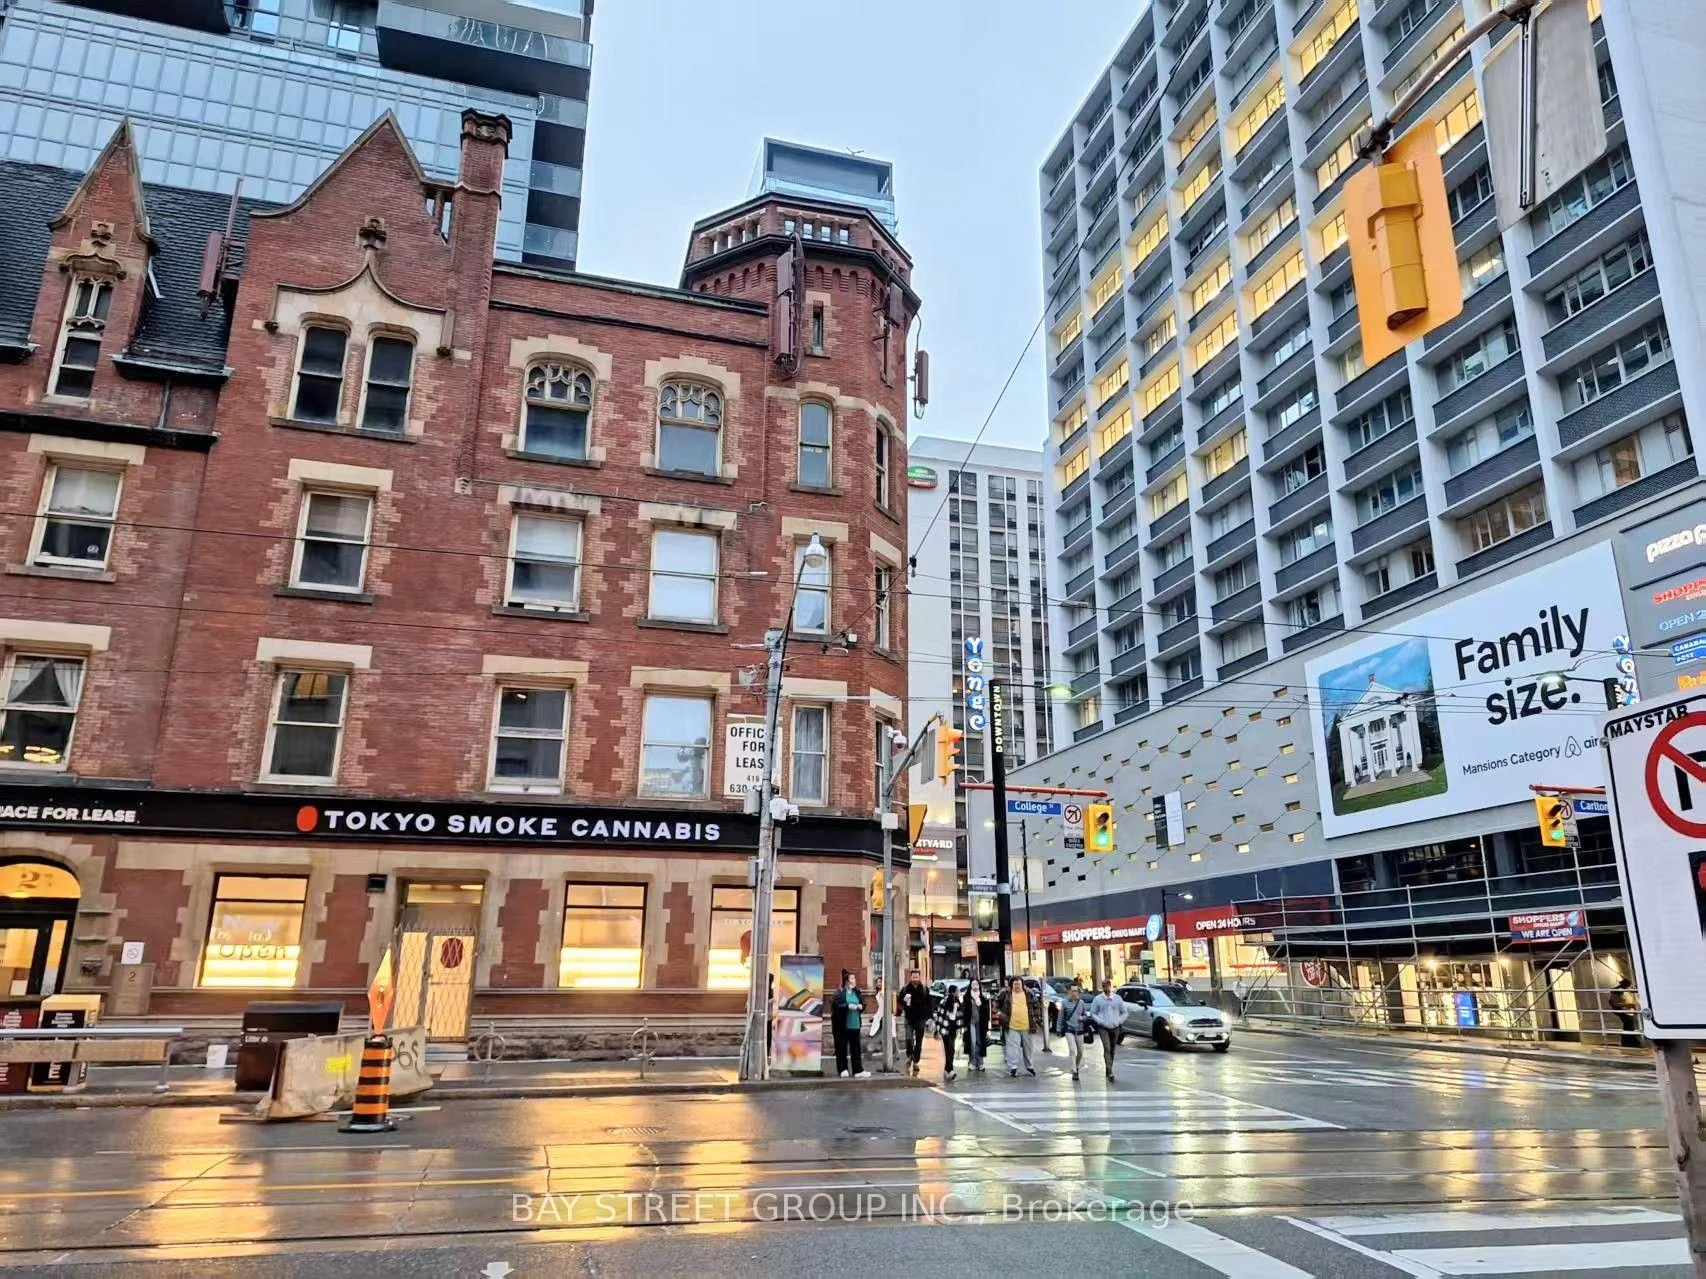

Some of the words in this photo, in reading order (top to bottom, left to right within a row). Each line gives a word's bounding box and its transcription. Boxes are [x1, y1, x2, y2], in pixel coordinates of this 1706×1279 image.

[1659, 612, 1694, 631] OPEN
[1454, 605, 1589, 681] Family
[966, 637, 985, 731] Yonge
[1486, 677, 1581, 725] size.
[993, 684, 1003, 753] DOWNTOWN
[1609, 705, 1688, 739] MAYSTAR
[730, 727, 765, 738] OFFIC
[743, 742, 765, 752] FOR
[736, 757, 765, 769] LEAS
[1462, 757, 1508, 776] Mansions
[1510, 744, 1561, 766] Category
[1583, 736, 1600, 749] air
[41, 806, 79, 821] FOR
[81, 808, 137, 823] LEASE
[1014, 801, 1047, 814] College
[324, 809, 436, 832] TOKYO
[447, 814, 558, 836] SMOKE
[571, 818, 721, 841] CANNABIS
[1196, 920, 1217, 931] OPEN
[1217, 920, 1227, 928] 24
[1512, 914, 1565, 924] SHOPPERS
[1062, 926, 1111, 943] SHOPPERS
[1521, 930, 1534, 938] WE
[1536, 930, 1551, 938] ARE
[1552, 928, 1572, 937] OPEN
